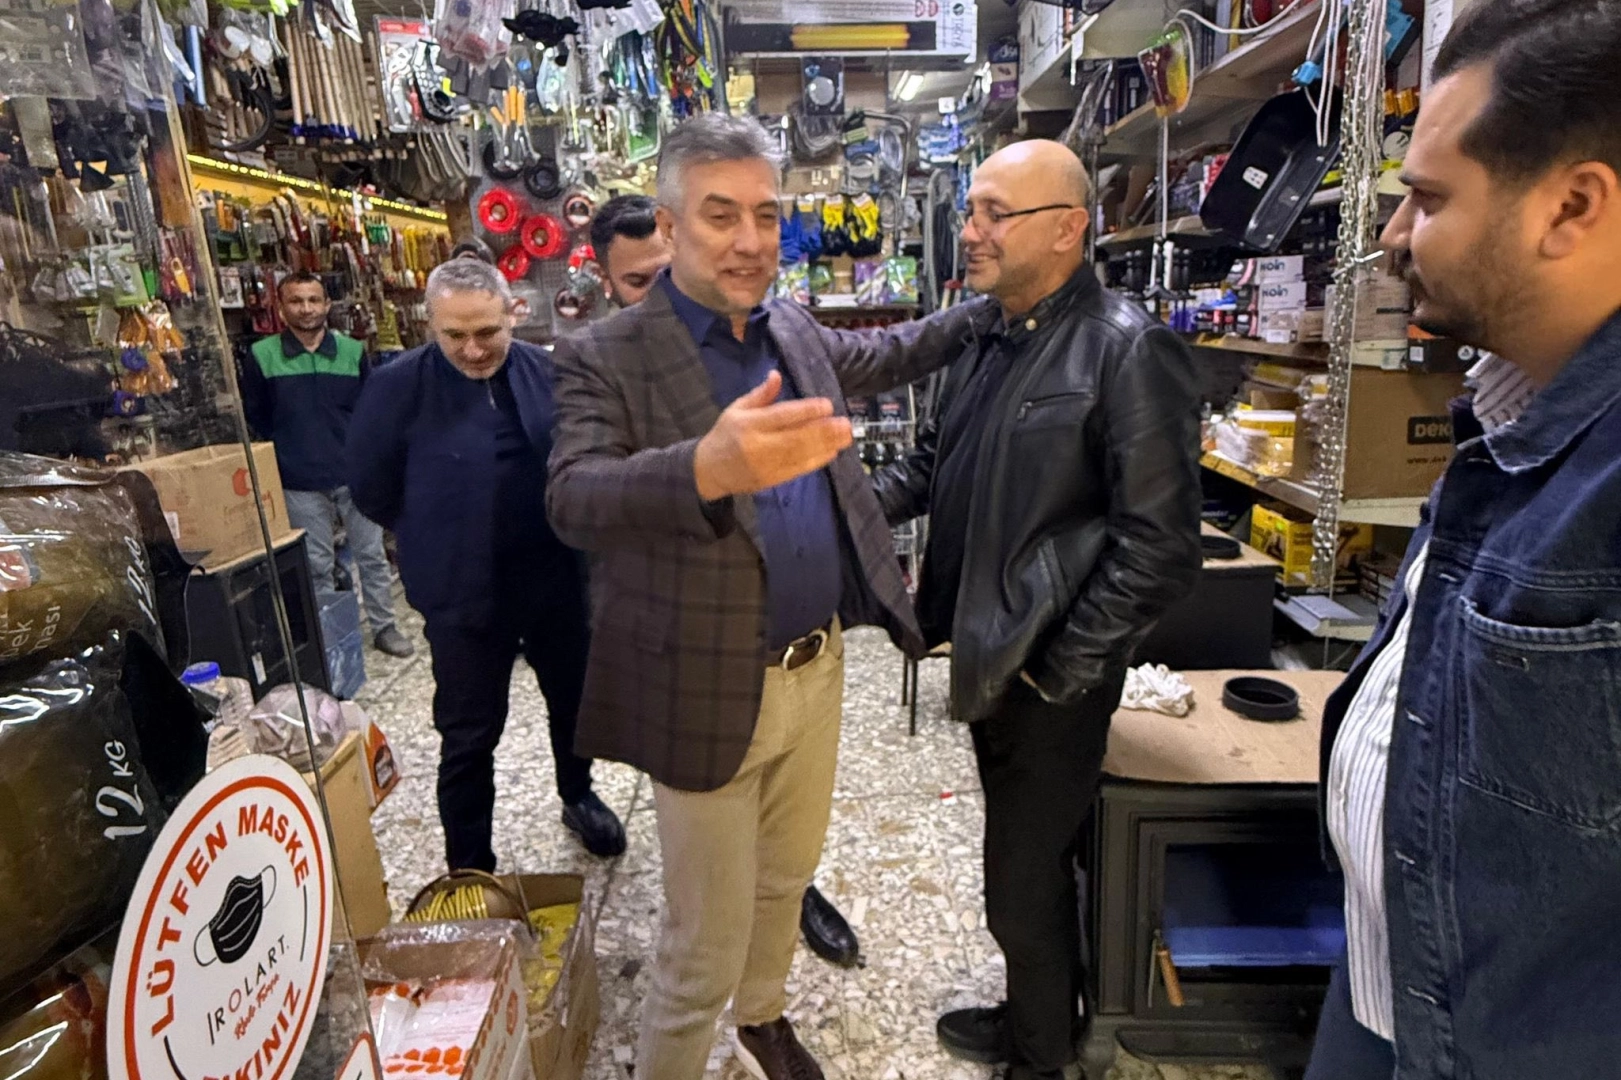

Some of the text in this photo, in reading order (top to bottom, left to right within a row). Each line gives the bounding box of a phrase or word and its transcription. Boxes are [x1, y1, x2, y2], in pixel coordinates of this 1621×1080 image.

[96, 740, 147, 840] 12 KG
[146, 803, 310, 1037] LÜTFEN MASKE
